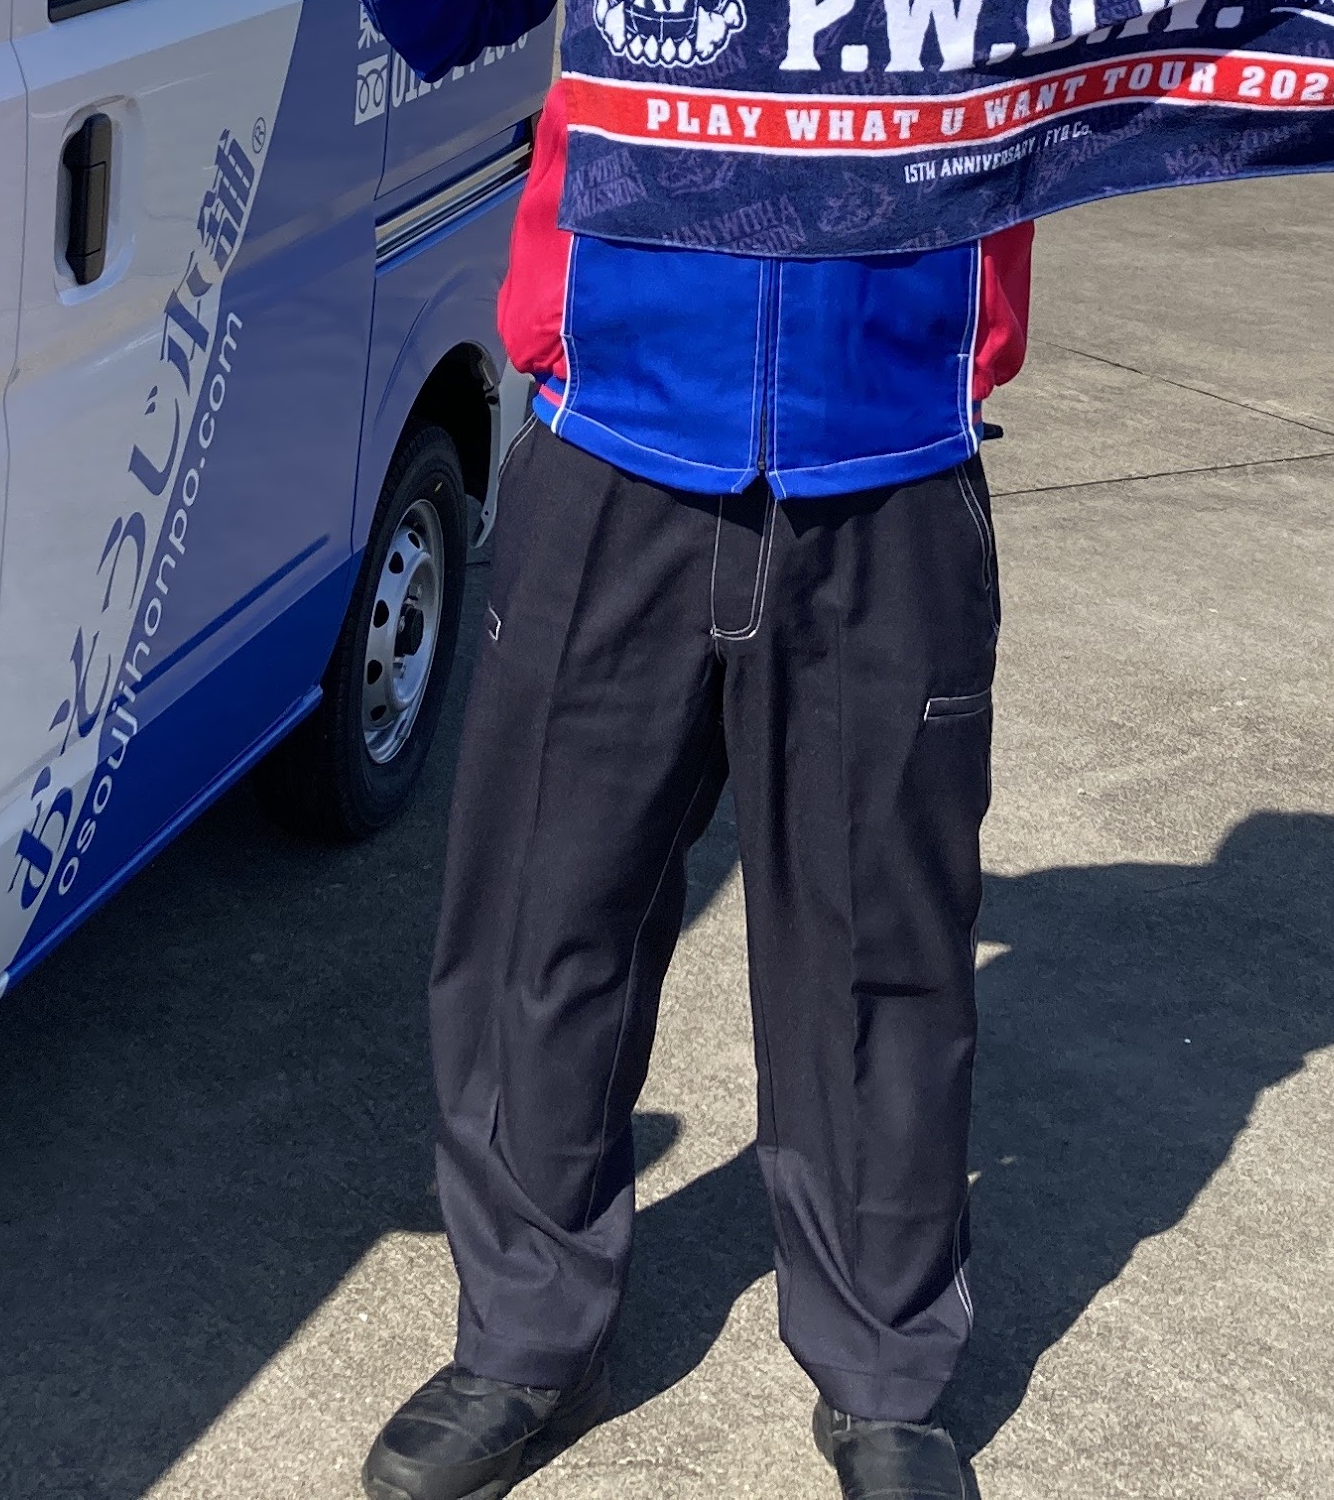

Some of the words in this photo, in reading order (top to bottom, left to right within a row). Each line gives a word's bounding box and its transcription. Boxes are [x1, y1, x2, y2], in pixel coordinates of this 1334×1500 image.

[646, 98, 763, 138] PLAY
[784, 108, 920, 142] WHAT
[940, 107, 965, 136] U
[983, 75, 1087, 129] WANT
[1102, 61, 1216, 95] TOUR
[904, 160, 936, 184] 15TH
[940, 137, 1036, 178] ANNIVERSARY
[8, 128, 257, 912] おそうじ本舗
[57, 311, 244, 897] osoujihonpo.com
